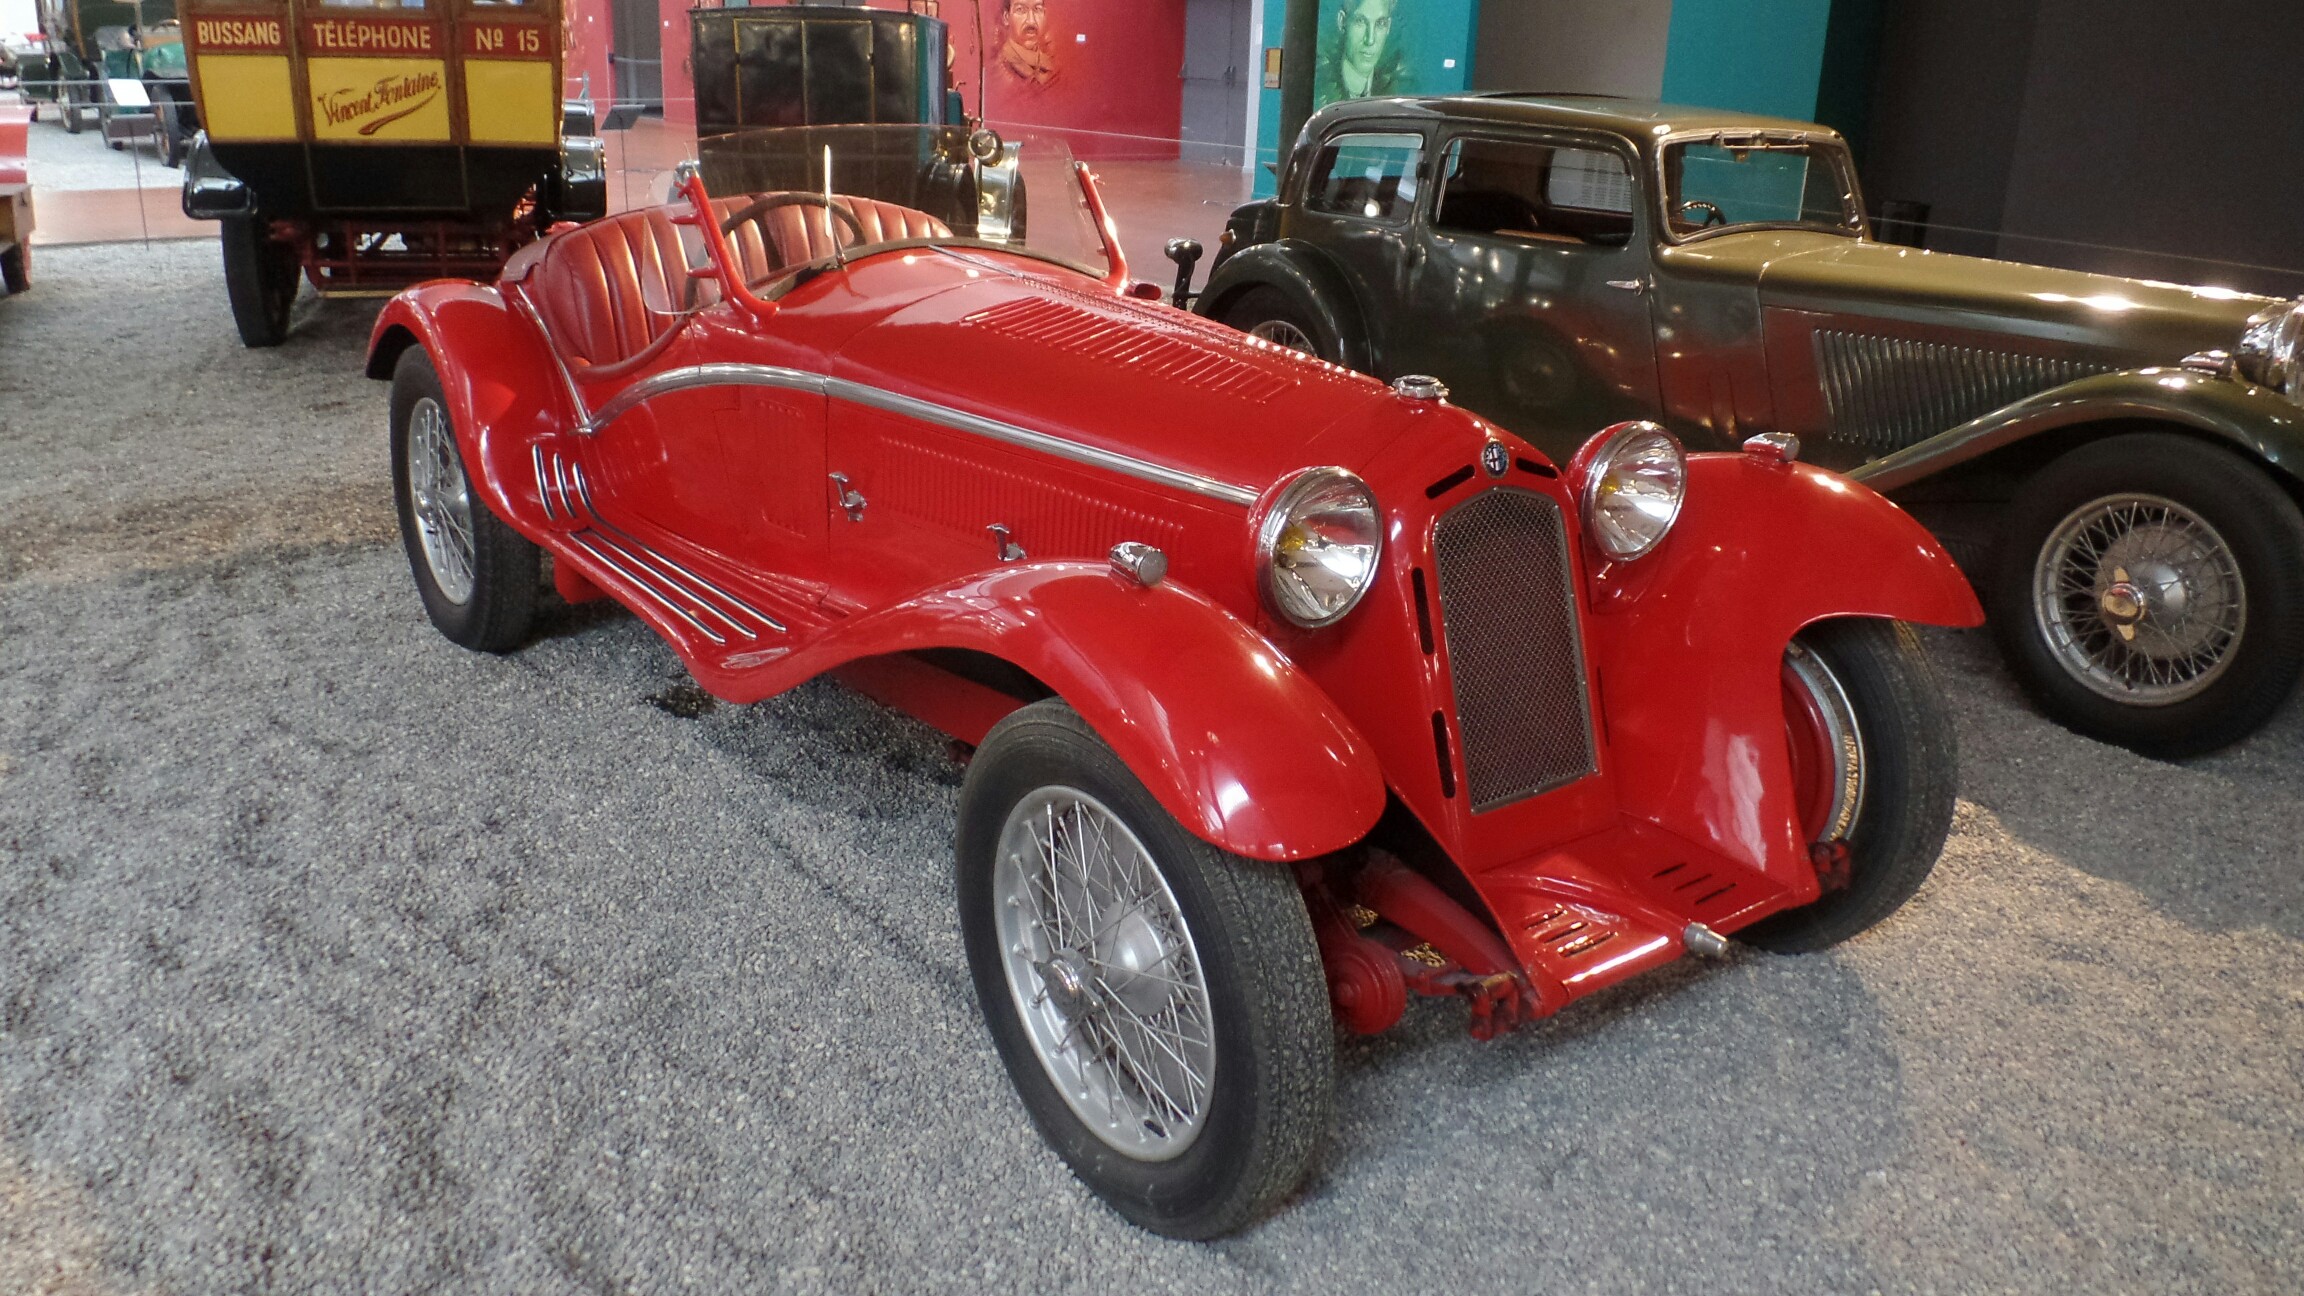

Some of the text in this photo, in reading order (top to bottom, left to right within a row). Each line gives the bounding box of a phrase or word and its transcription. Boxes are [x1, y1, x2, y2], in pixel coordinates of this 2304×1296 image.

[197, 21, 280, 44] BUSSANG
[313, 20, 431, 49] TÉLÉPHONE
[517, 29, 539, 52] 15
[317, 87, 376, 126] Vincent
